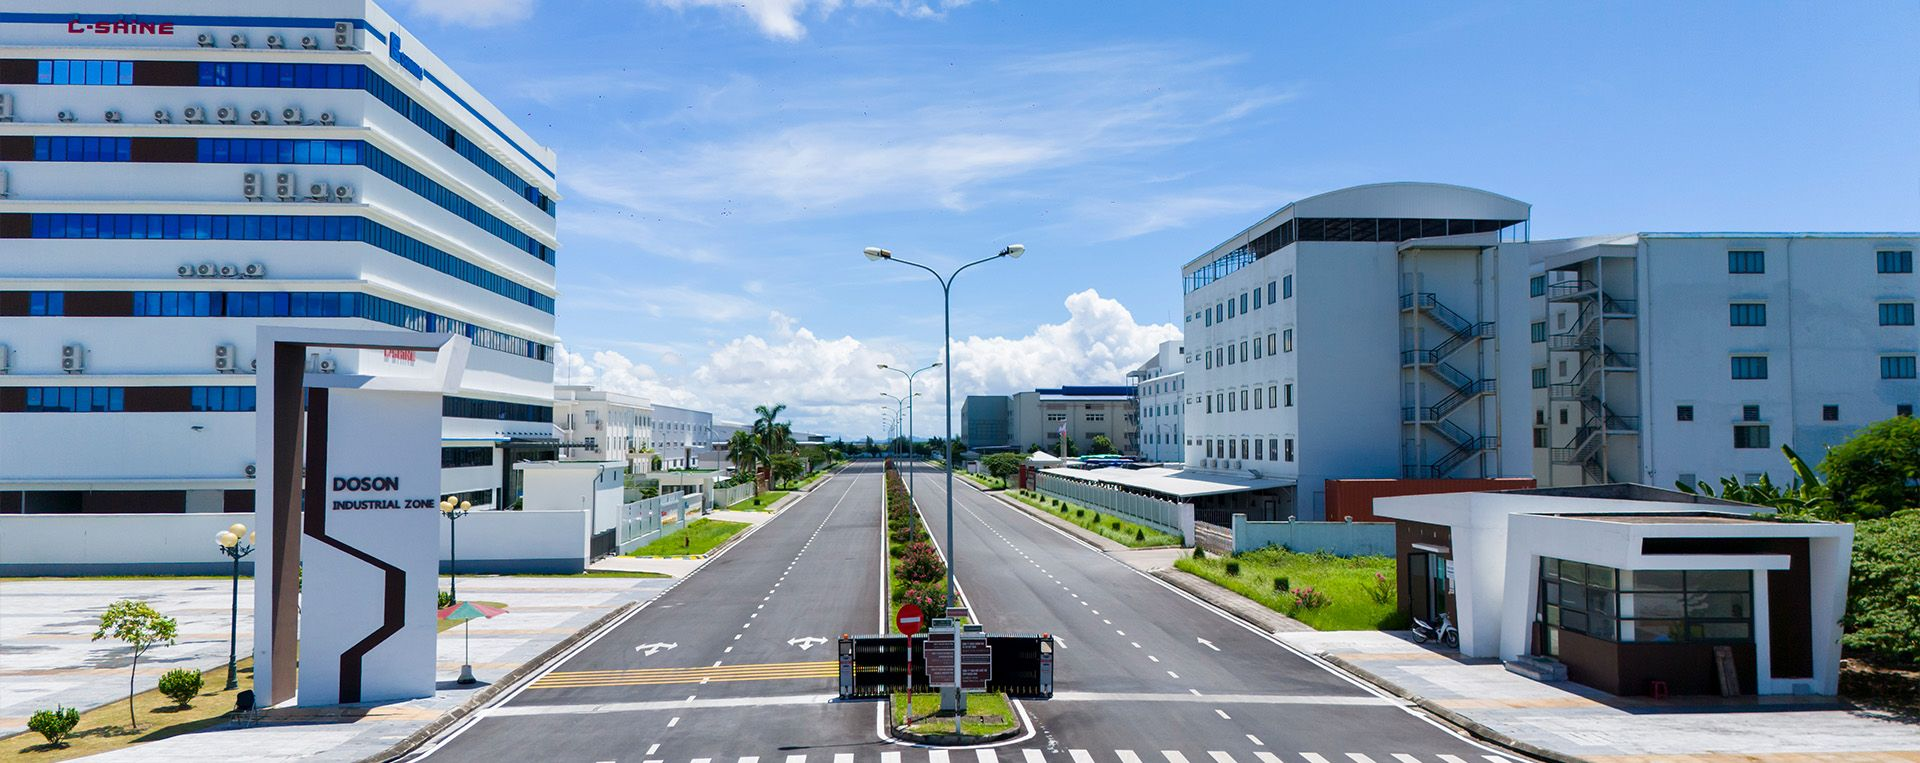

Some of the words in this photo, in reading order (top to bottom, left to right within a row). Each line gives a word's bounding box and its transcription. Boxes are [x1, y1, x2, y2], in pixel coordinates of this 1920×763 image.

[333, 477, 399, 491] DOSON
[332, 500, 400, 510] INDUSTRIAL
[405, 499, 435, 509] ZONE
